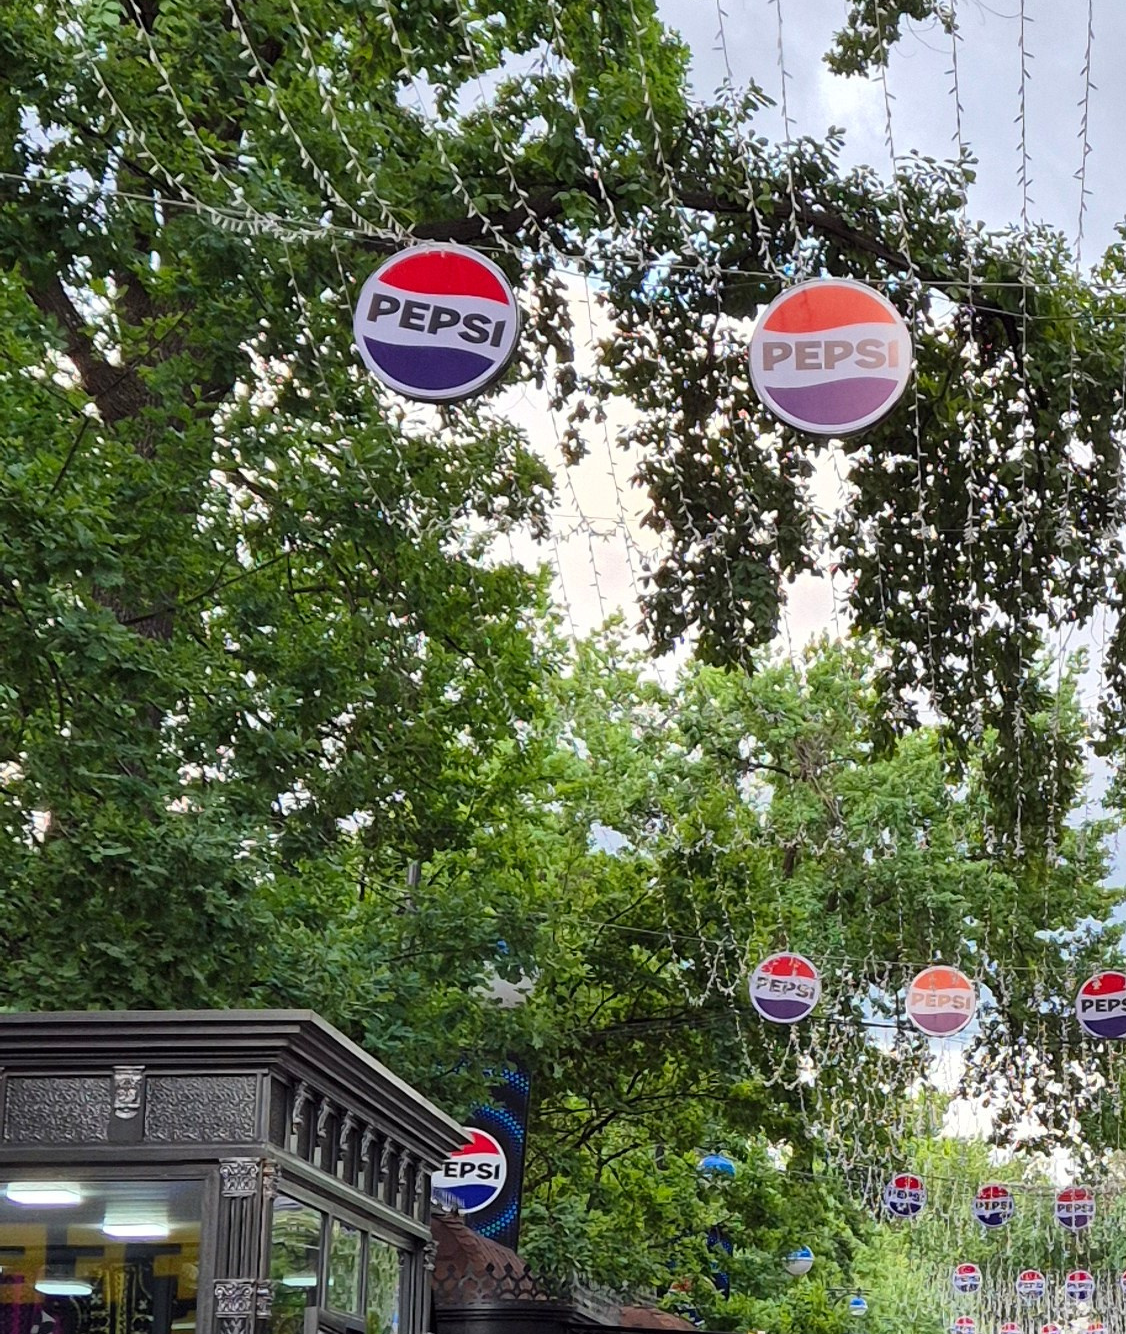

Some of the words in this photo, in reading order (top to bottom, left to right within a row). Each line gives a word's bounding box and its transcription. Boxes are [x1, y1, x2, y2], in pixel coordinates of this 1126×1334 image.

[367, 293, 506, 348] PEPSI
[763, 338, 899, 371] PEPSI
[756, 976, 816, 1000] PEPSI
[911, 992, 971, 1010] PEPSI
[443, 1161, 501, 1180] EPSI
